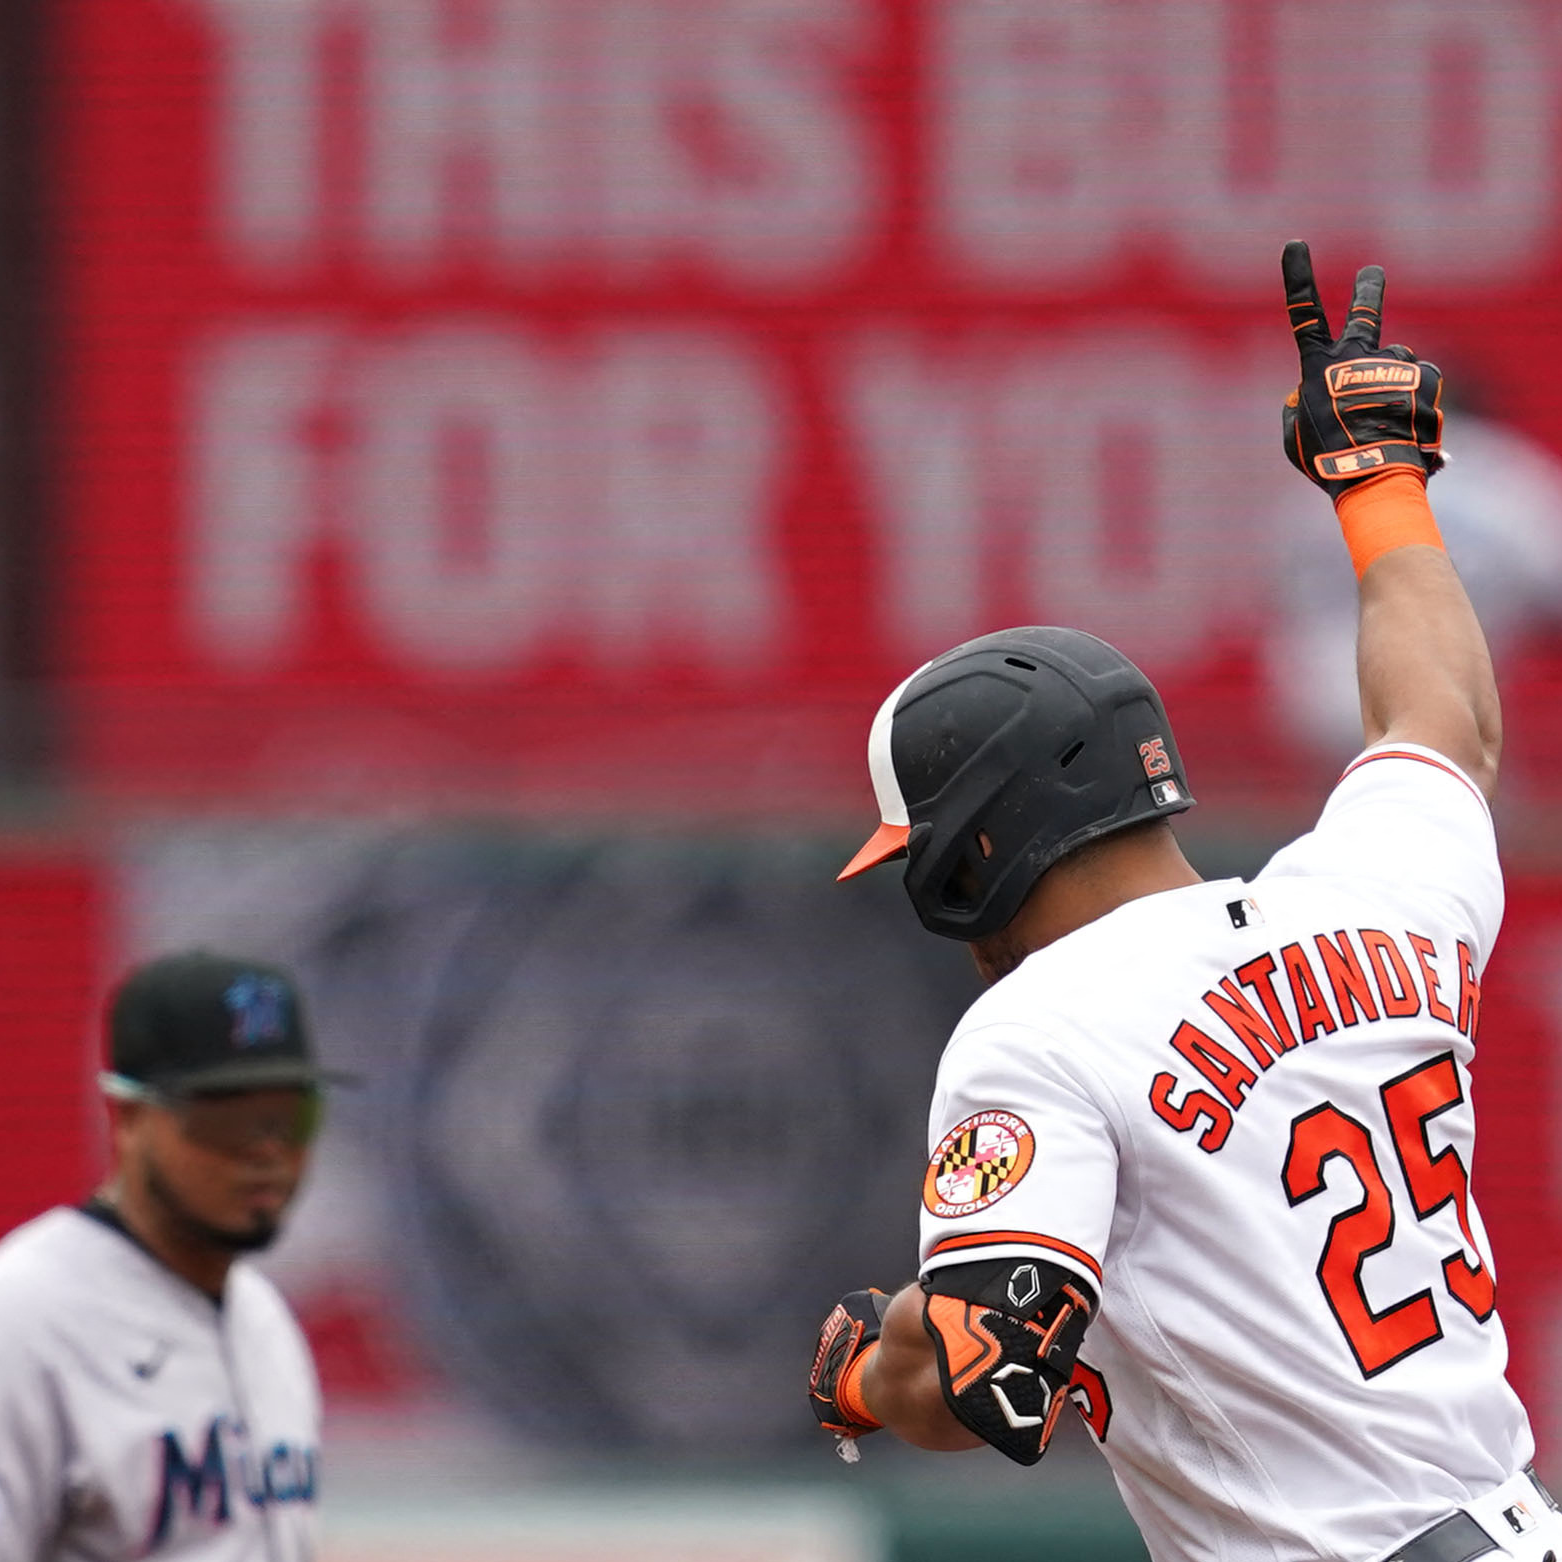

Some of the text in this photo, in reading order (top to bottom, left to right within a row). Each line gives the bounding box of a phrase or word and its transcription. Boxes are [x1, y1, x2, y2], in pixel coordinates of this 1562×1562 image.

[203, 0, 870, 276] THIS
[1334, 365, 1415, 392] Franklin
[193, 325, 779, 668] FOR
[1139, 738, 1171, 778] 25
[1148, 926, 1482, 1154] SANTANDER
[930, 1112, 1030, 1166] BALTIMORE
[934, 1180, 1014, 1216] ORIOLES
[1283, 1050, 1497, 1380] 25
